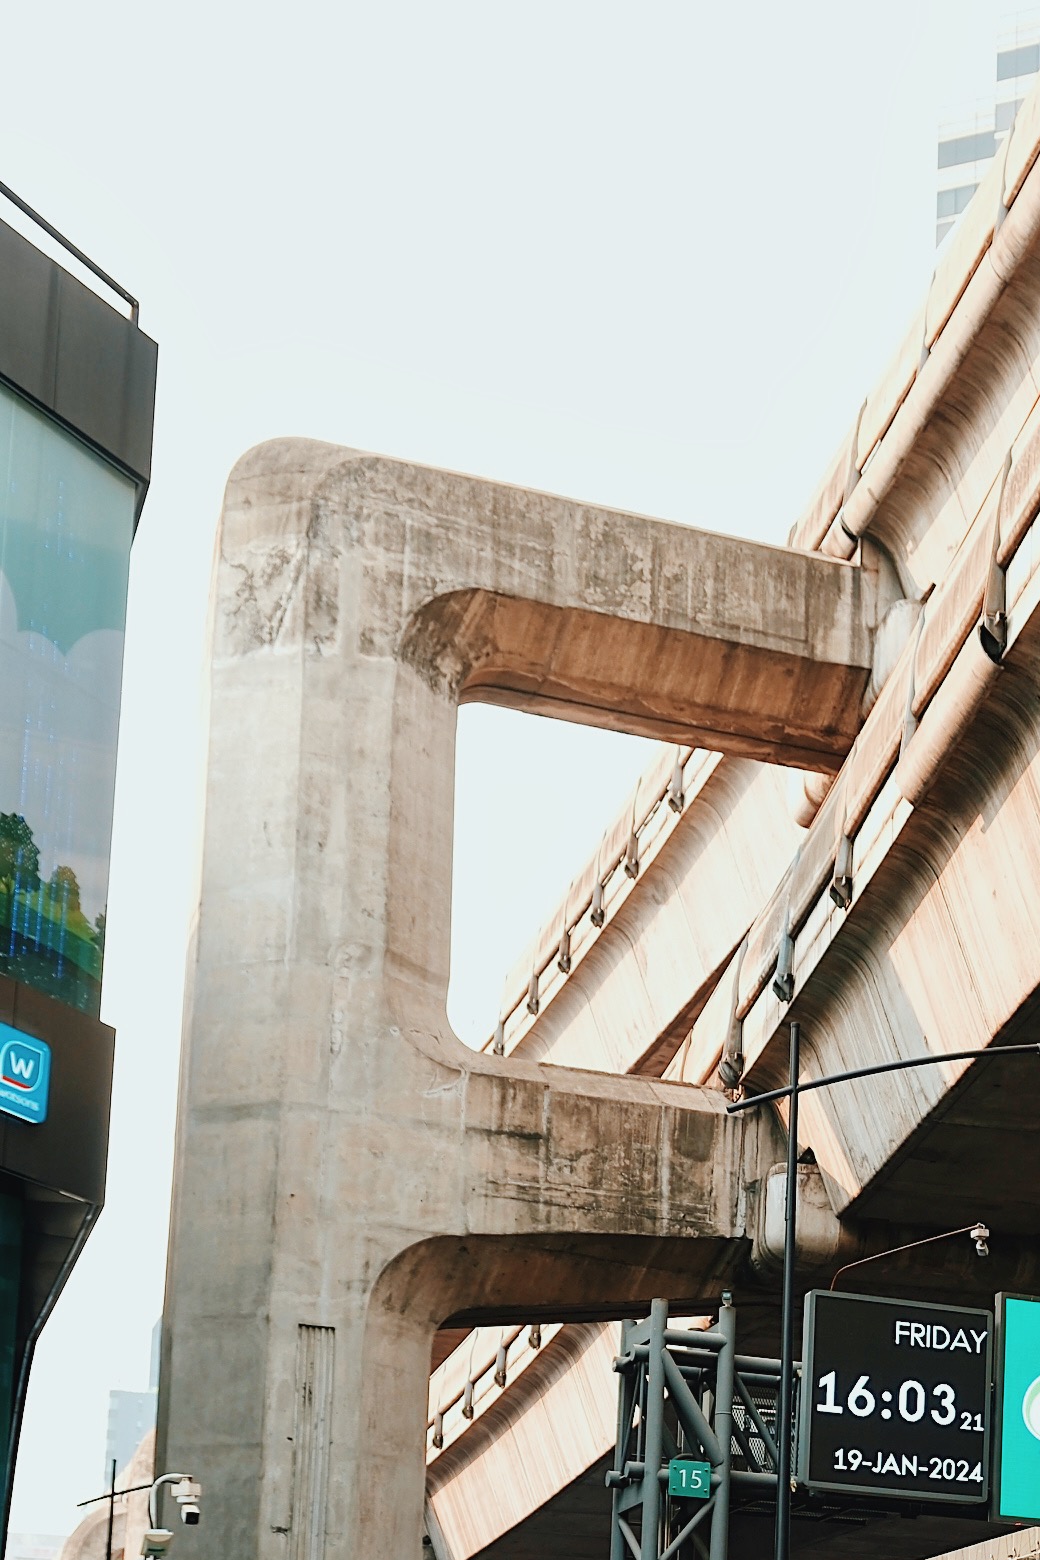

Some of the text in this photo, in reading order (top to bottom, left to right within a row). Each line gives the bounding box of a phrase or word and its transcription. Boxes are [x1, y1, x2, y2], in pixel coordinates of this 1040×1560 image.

[895, 1320, 988, 1354] FRIDAY
[816, 1370, 985, 1432] 16:03 21
[679, 1470, 702, 1489] 15
[833, 1448, 984, 1483] 19-JAN-2024
